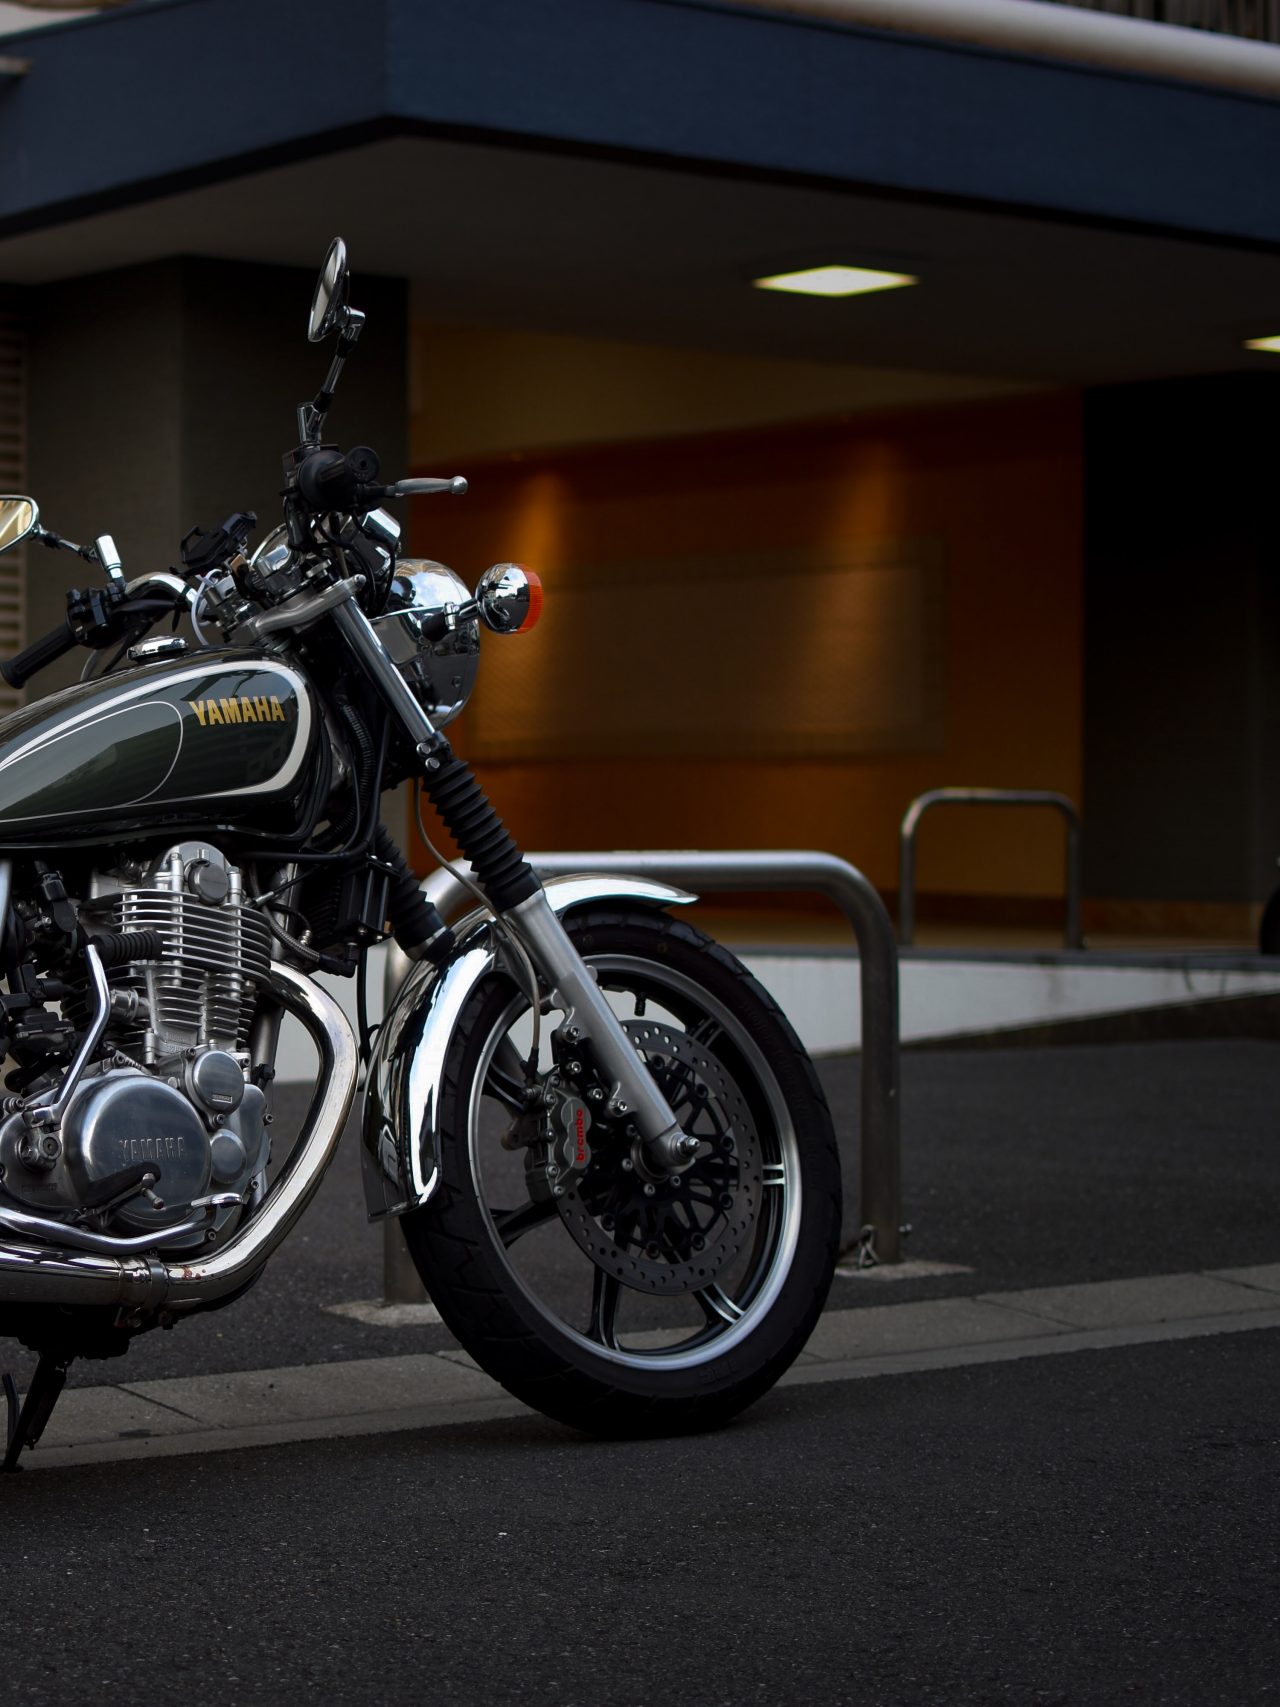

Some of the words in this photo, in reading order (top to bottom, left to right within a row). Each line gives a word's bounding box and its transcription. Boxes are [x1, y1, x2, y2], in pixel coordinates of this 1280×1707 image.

[188, 695, 286, 726] YAMAHA
[119, 1136, 184, 1161] YAMAHA
[575, 1108, 585, 1162] brembo
